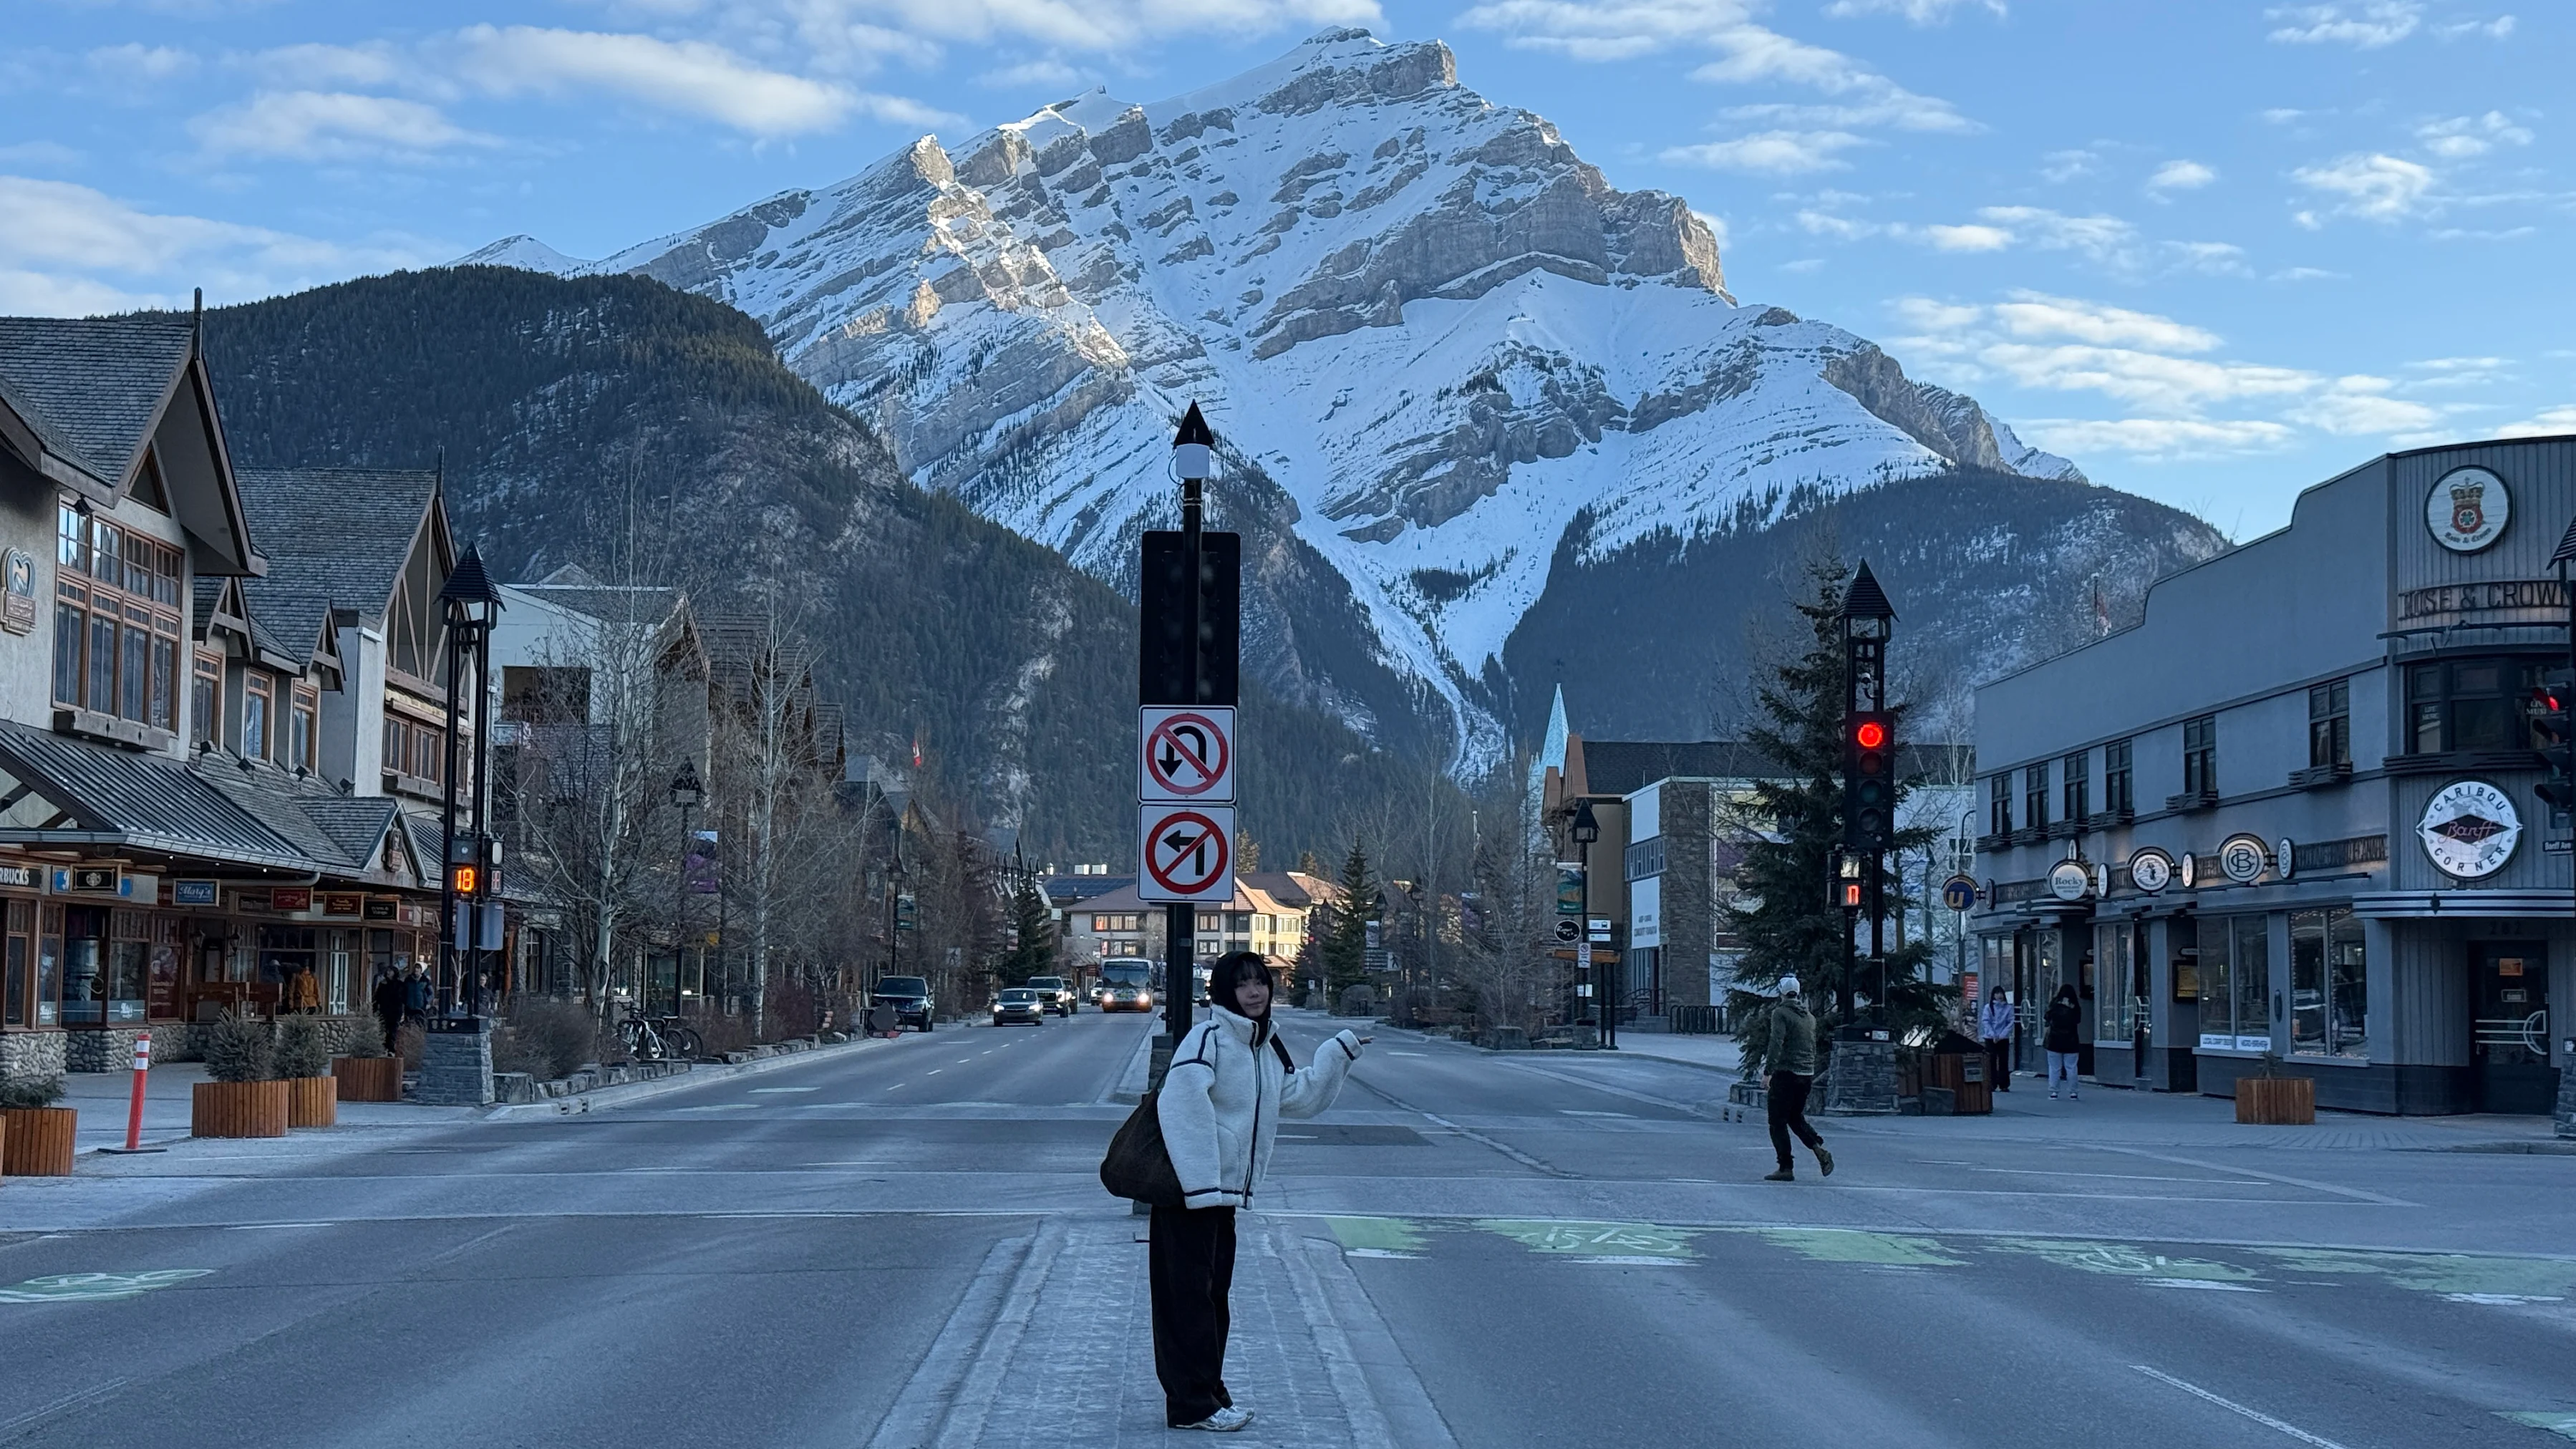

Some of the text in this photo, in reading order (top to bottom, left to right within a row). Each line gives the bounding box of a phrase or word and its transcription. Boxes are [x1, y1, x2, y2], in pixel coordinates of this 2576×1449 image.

[2460, 583, 2477, 609] &
[2434, 785, 2507, 812] CARIBOU
[2437, 820, 2497, 844] Banff
[2434, 845, 2507, 873] CORNER
[456, 868, 475, 891] 18
[2055, 876, 2085, 886] Rocky
